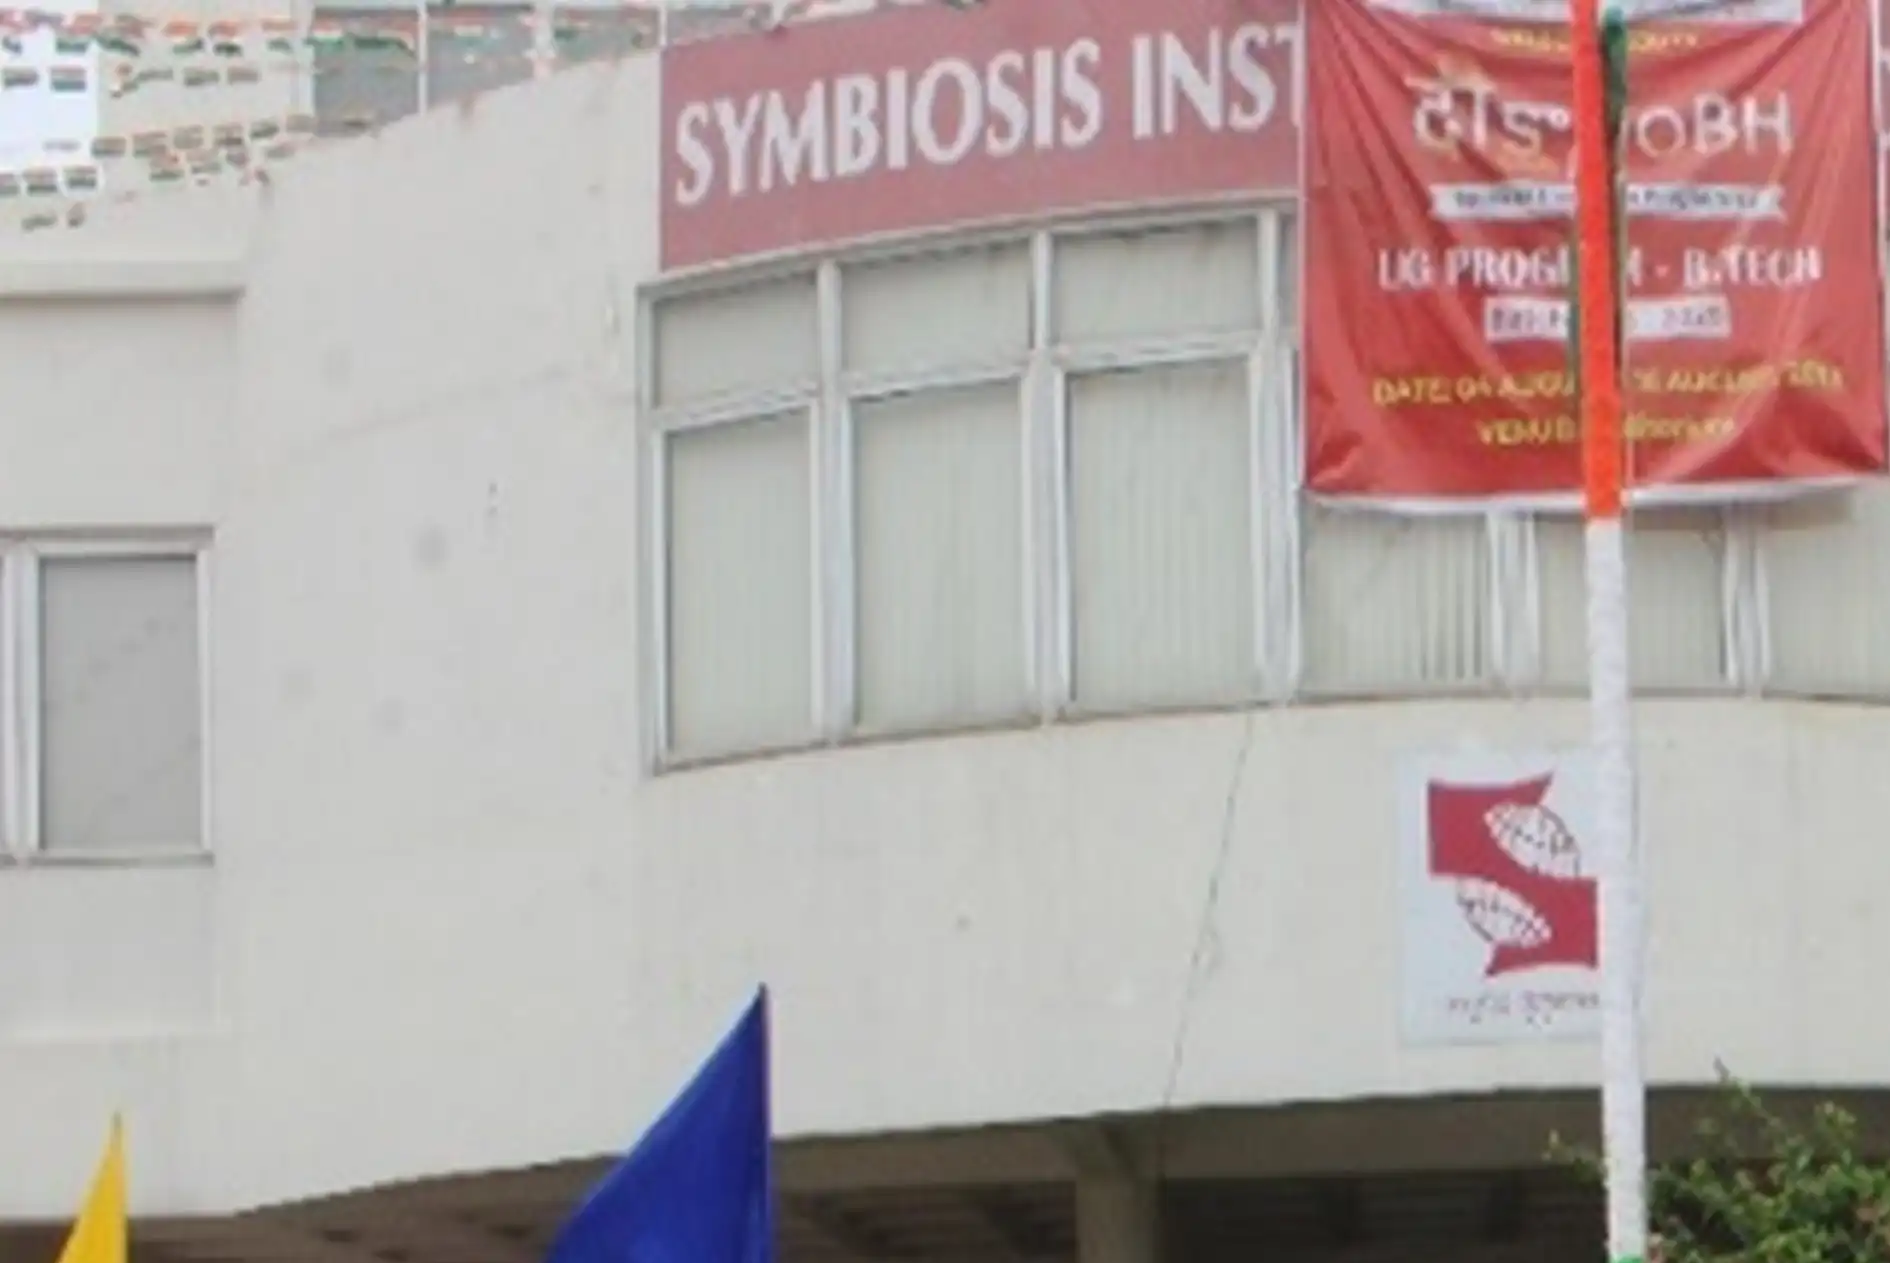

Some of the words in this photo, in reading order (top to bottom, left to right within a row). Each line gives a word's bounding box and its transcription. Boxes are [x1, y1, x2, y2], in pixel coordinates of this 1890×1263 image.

[675, 37, 1102, 207] SYMBIOSIS
[1378, 247, 1432, 290] UG
[1684, 243, 1823, 289] B.TECH
